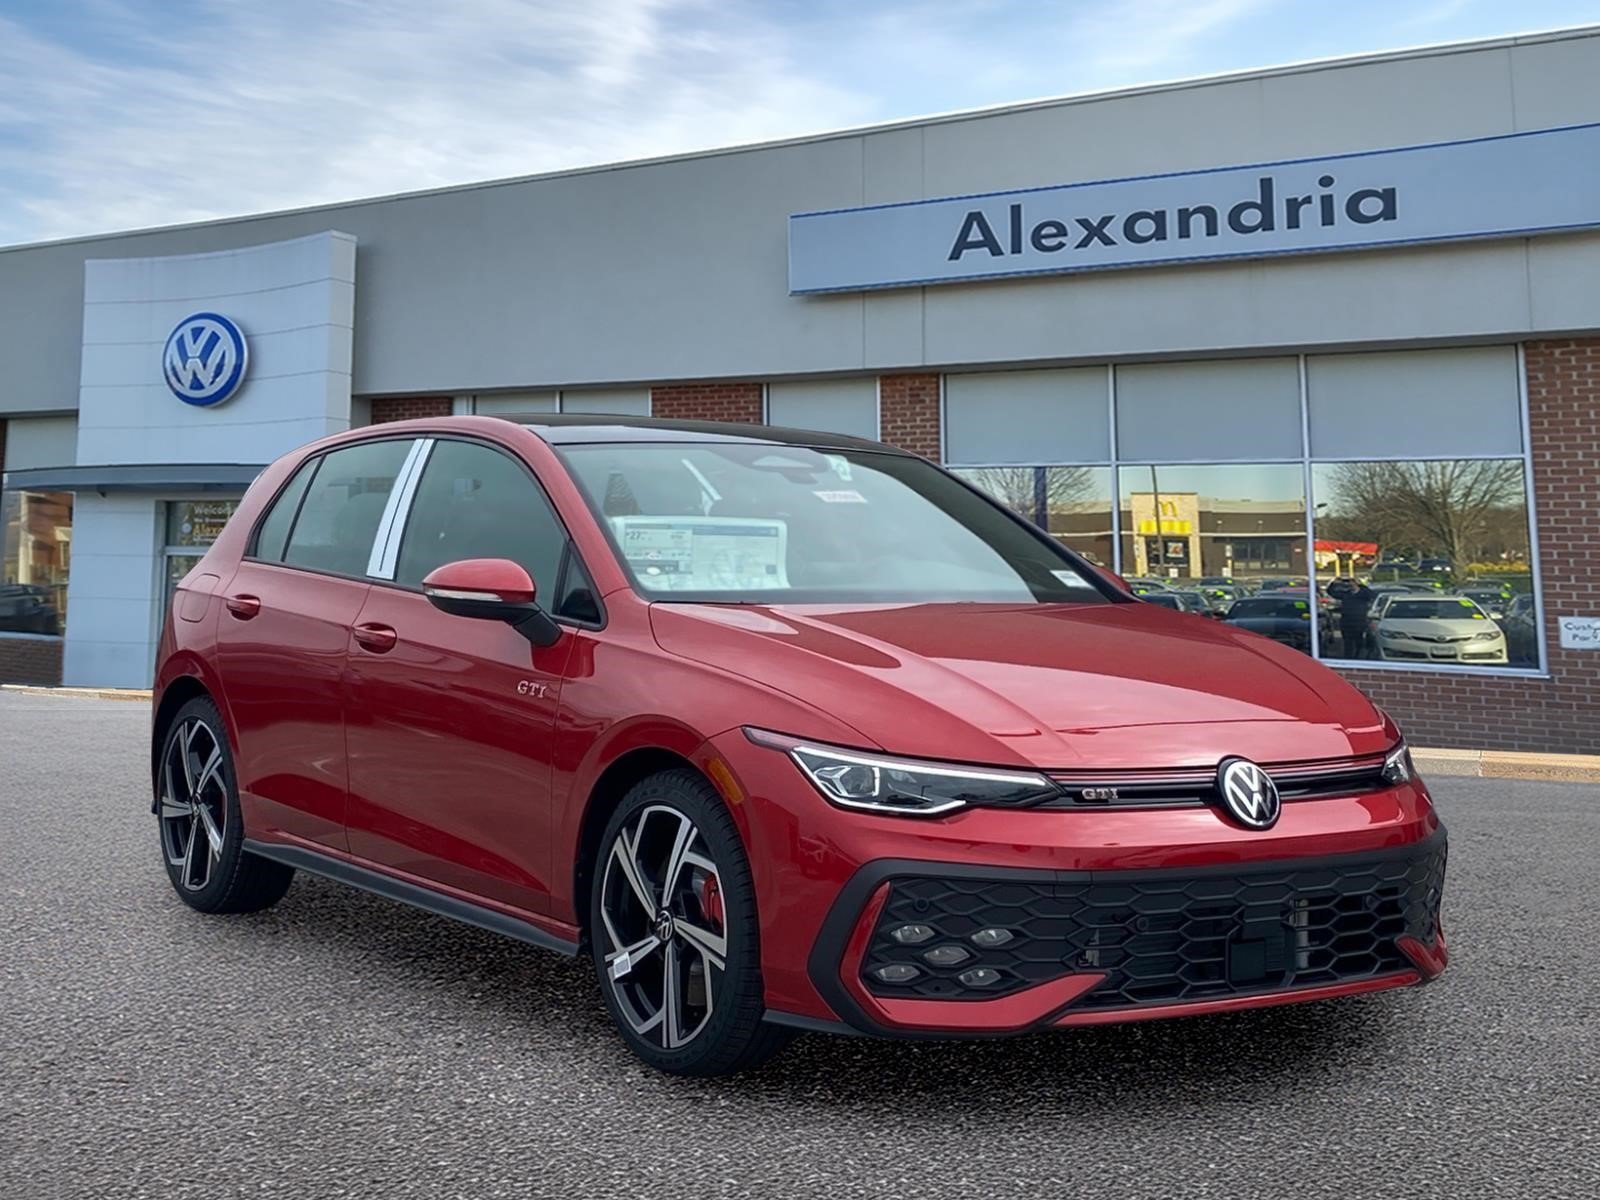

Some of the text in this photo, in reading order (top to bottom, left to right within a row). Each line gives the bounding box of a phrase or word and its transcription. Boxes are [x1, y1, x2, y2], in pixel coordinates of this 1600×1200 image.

[946, 174, 1398, 262] Alexandria
[164, 312, 245, 404] VW
[517, 680, 547, 698] GTI
[1081, 787, 1119, 801] GTI
[1221, 758, 1280, 829] VW
